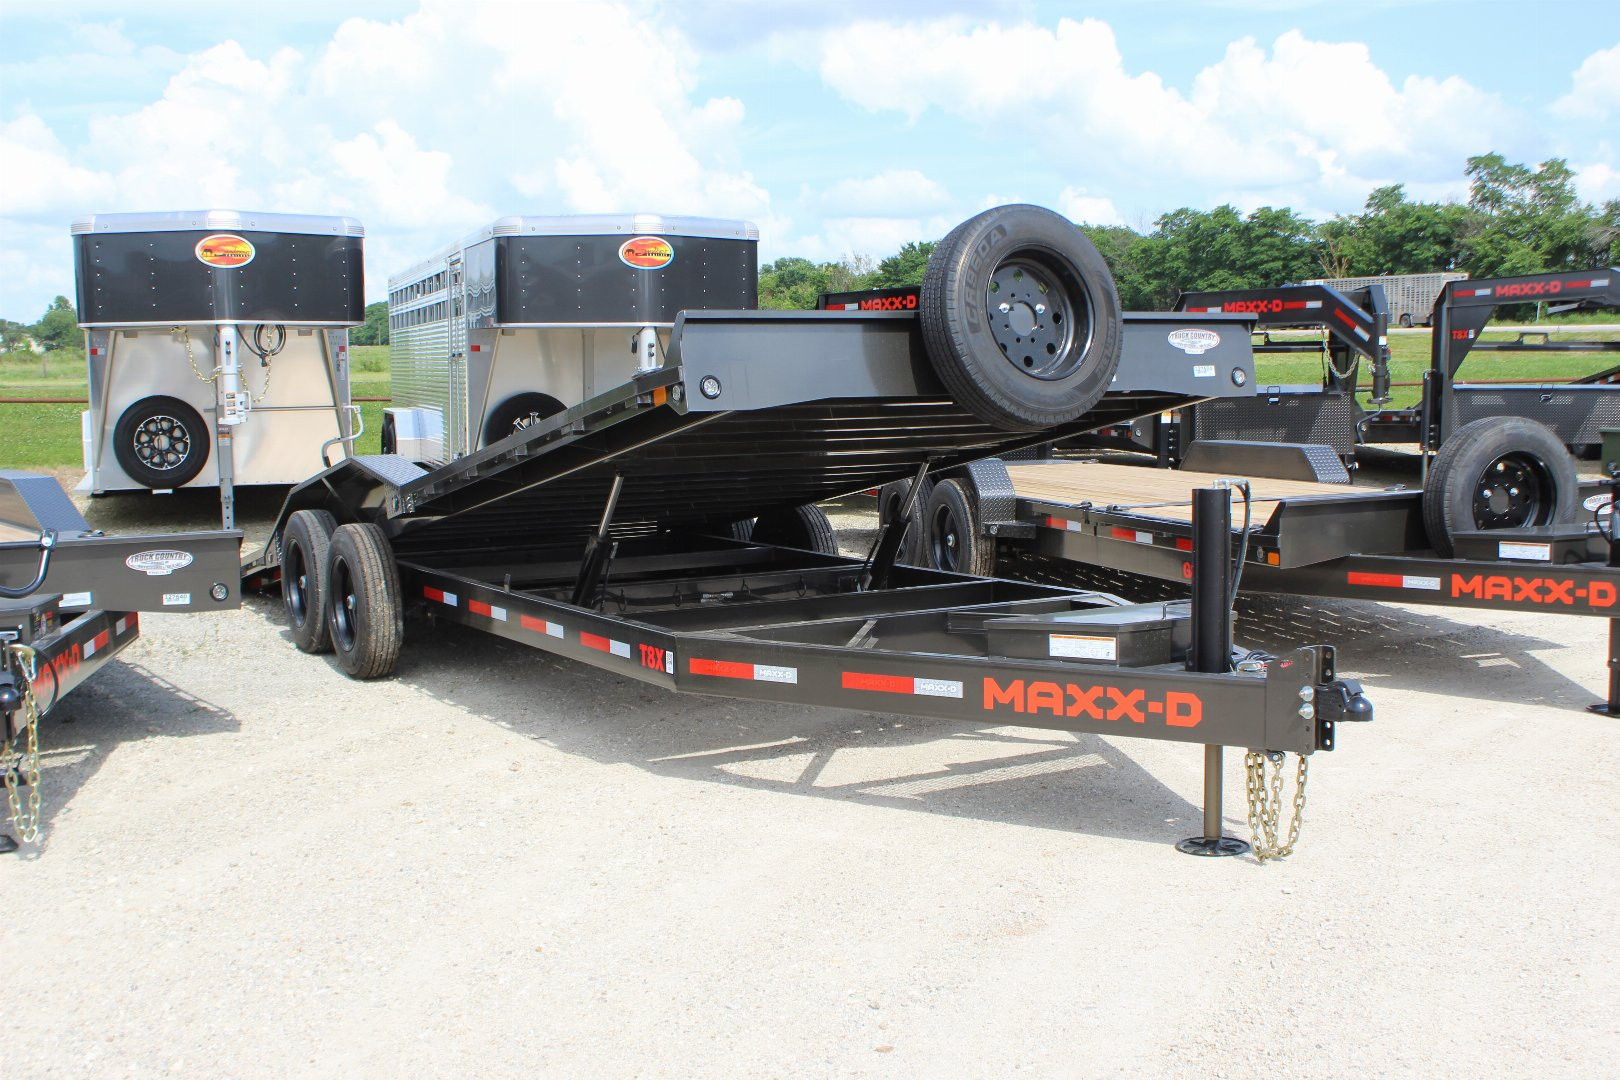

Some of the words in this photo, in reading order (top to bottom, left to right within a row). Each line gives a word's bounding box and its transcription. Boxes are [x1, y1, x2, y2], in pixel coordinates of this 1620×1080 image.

[1495, 280, 1562, 297] MAXX-D
[861, 295, 917, 311] MAXX-D
[1223, 299, 1283, 313] MAXX-D
[131, 553, 154, 563] TRUCK
[155, 552, 187, 561] COUNTRY
[1451, 573, 1617, 608] MAXX-D
[639, 643, 665, 673] T8X
[759, 668, 792, 680] MAXX-D
[920, 683, 957, 694] MAXX-D
[983, 677, 1202, 728] MAXX-D
